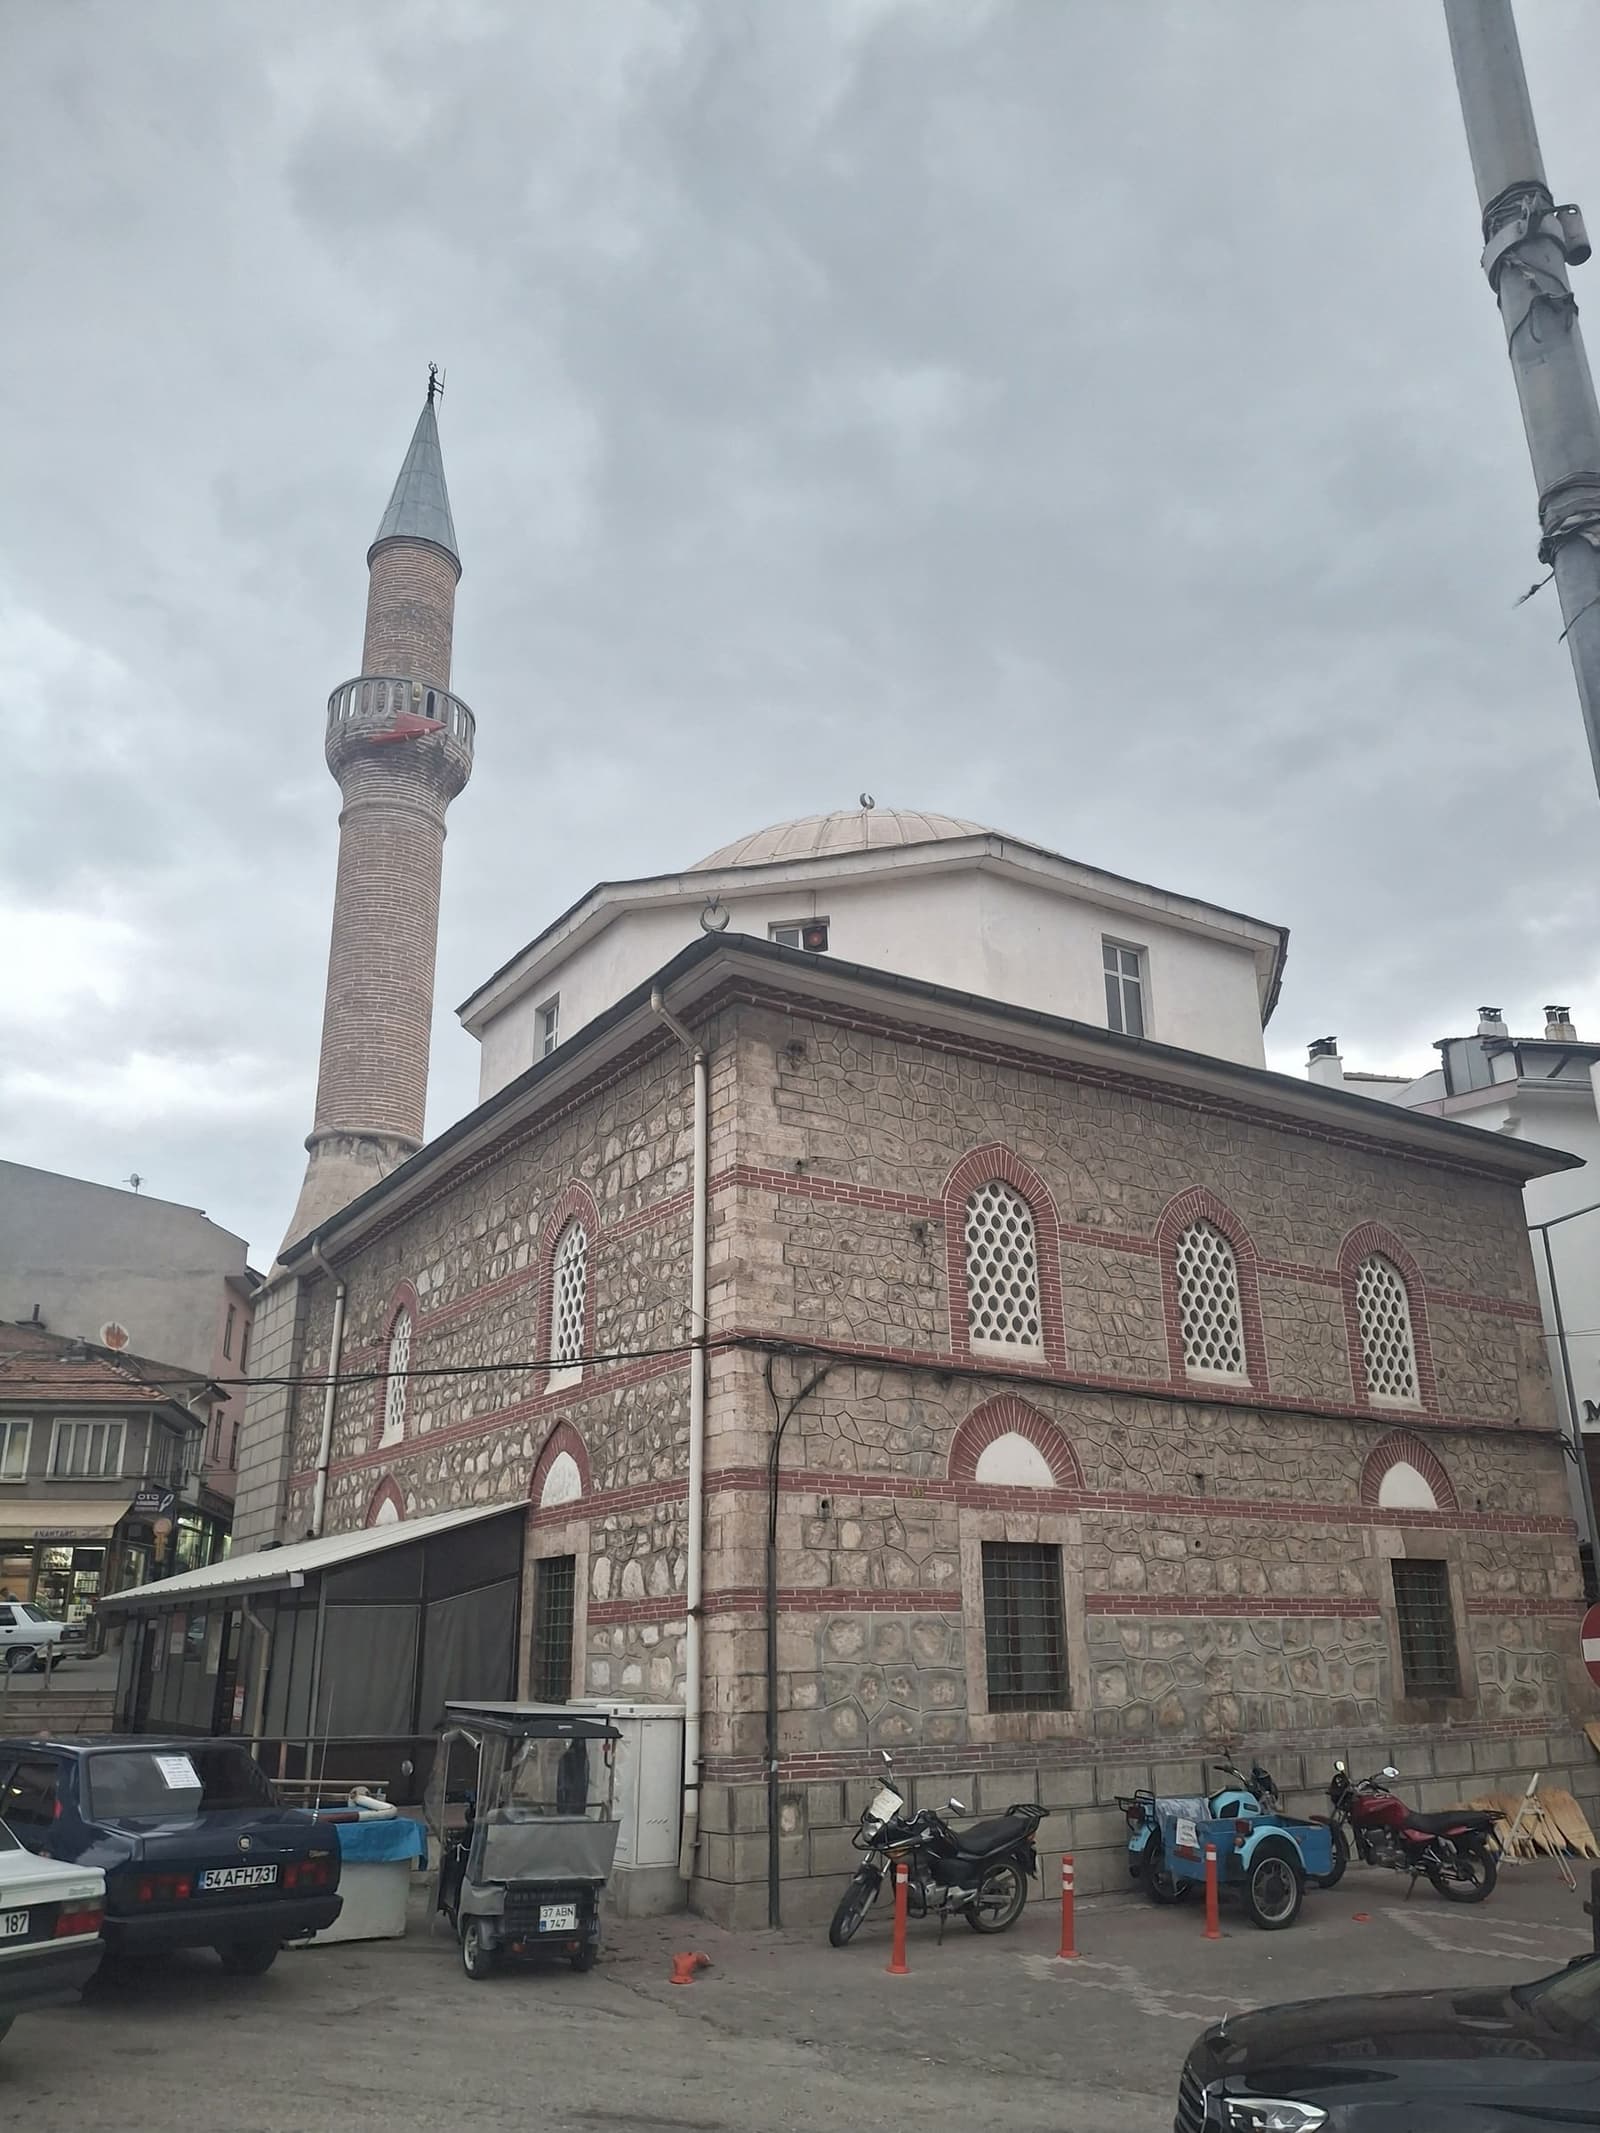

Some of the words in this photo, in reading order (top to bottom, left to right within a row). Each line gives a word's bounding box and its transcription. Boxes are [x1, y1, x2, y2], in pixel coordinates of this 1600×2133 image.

[206, 1872, 221, 1887] 54
[223, 1868, 254, 1885] AFH
[255, 1867, 276, 1882] 731
[543, 1908, 554, 1918] 37
[556, 1907, 574, 1916] ABN
[5, 1913, 27, 1934] 187
[550, 1919, 566, 1928] 747
